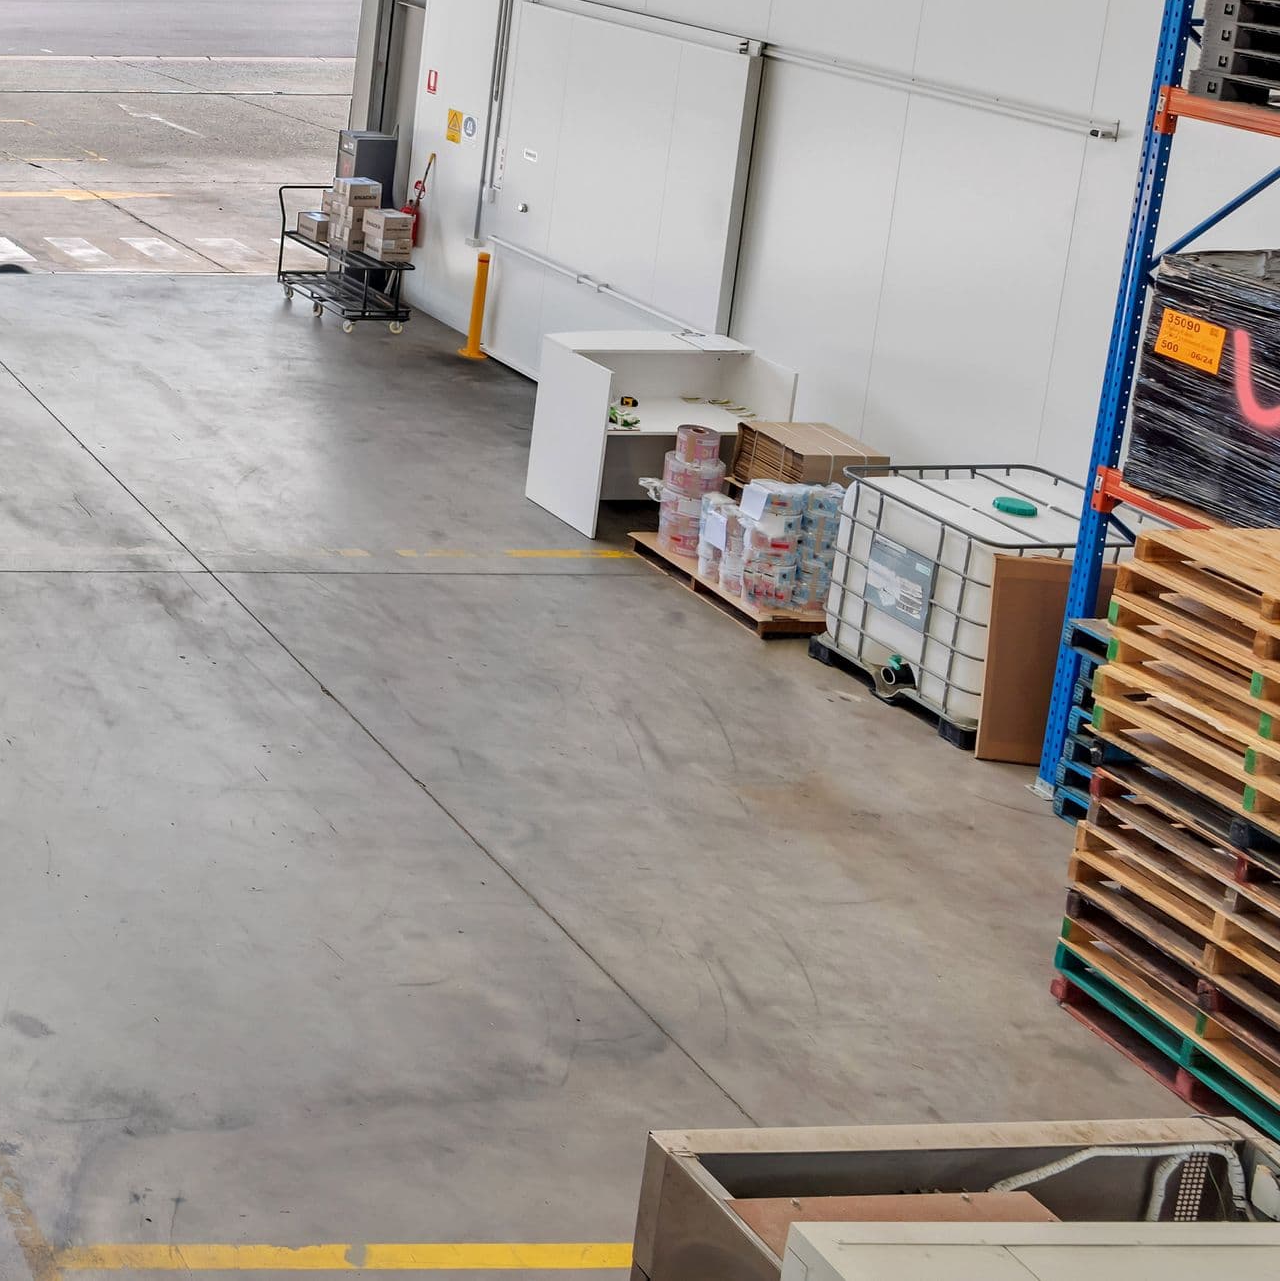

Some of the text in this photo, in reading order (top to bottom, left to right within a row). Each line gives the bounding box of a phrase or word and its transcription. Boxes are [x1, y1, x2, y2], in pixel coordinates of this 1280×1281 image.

[1167, 313, 1201, 333] 35090
[1160, 339, 1179, 353] 500
[1190, 351, 1213, 365] 06/24
